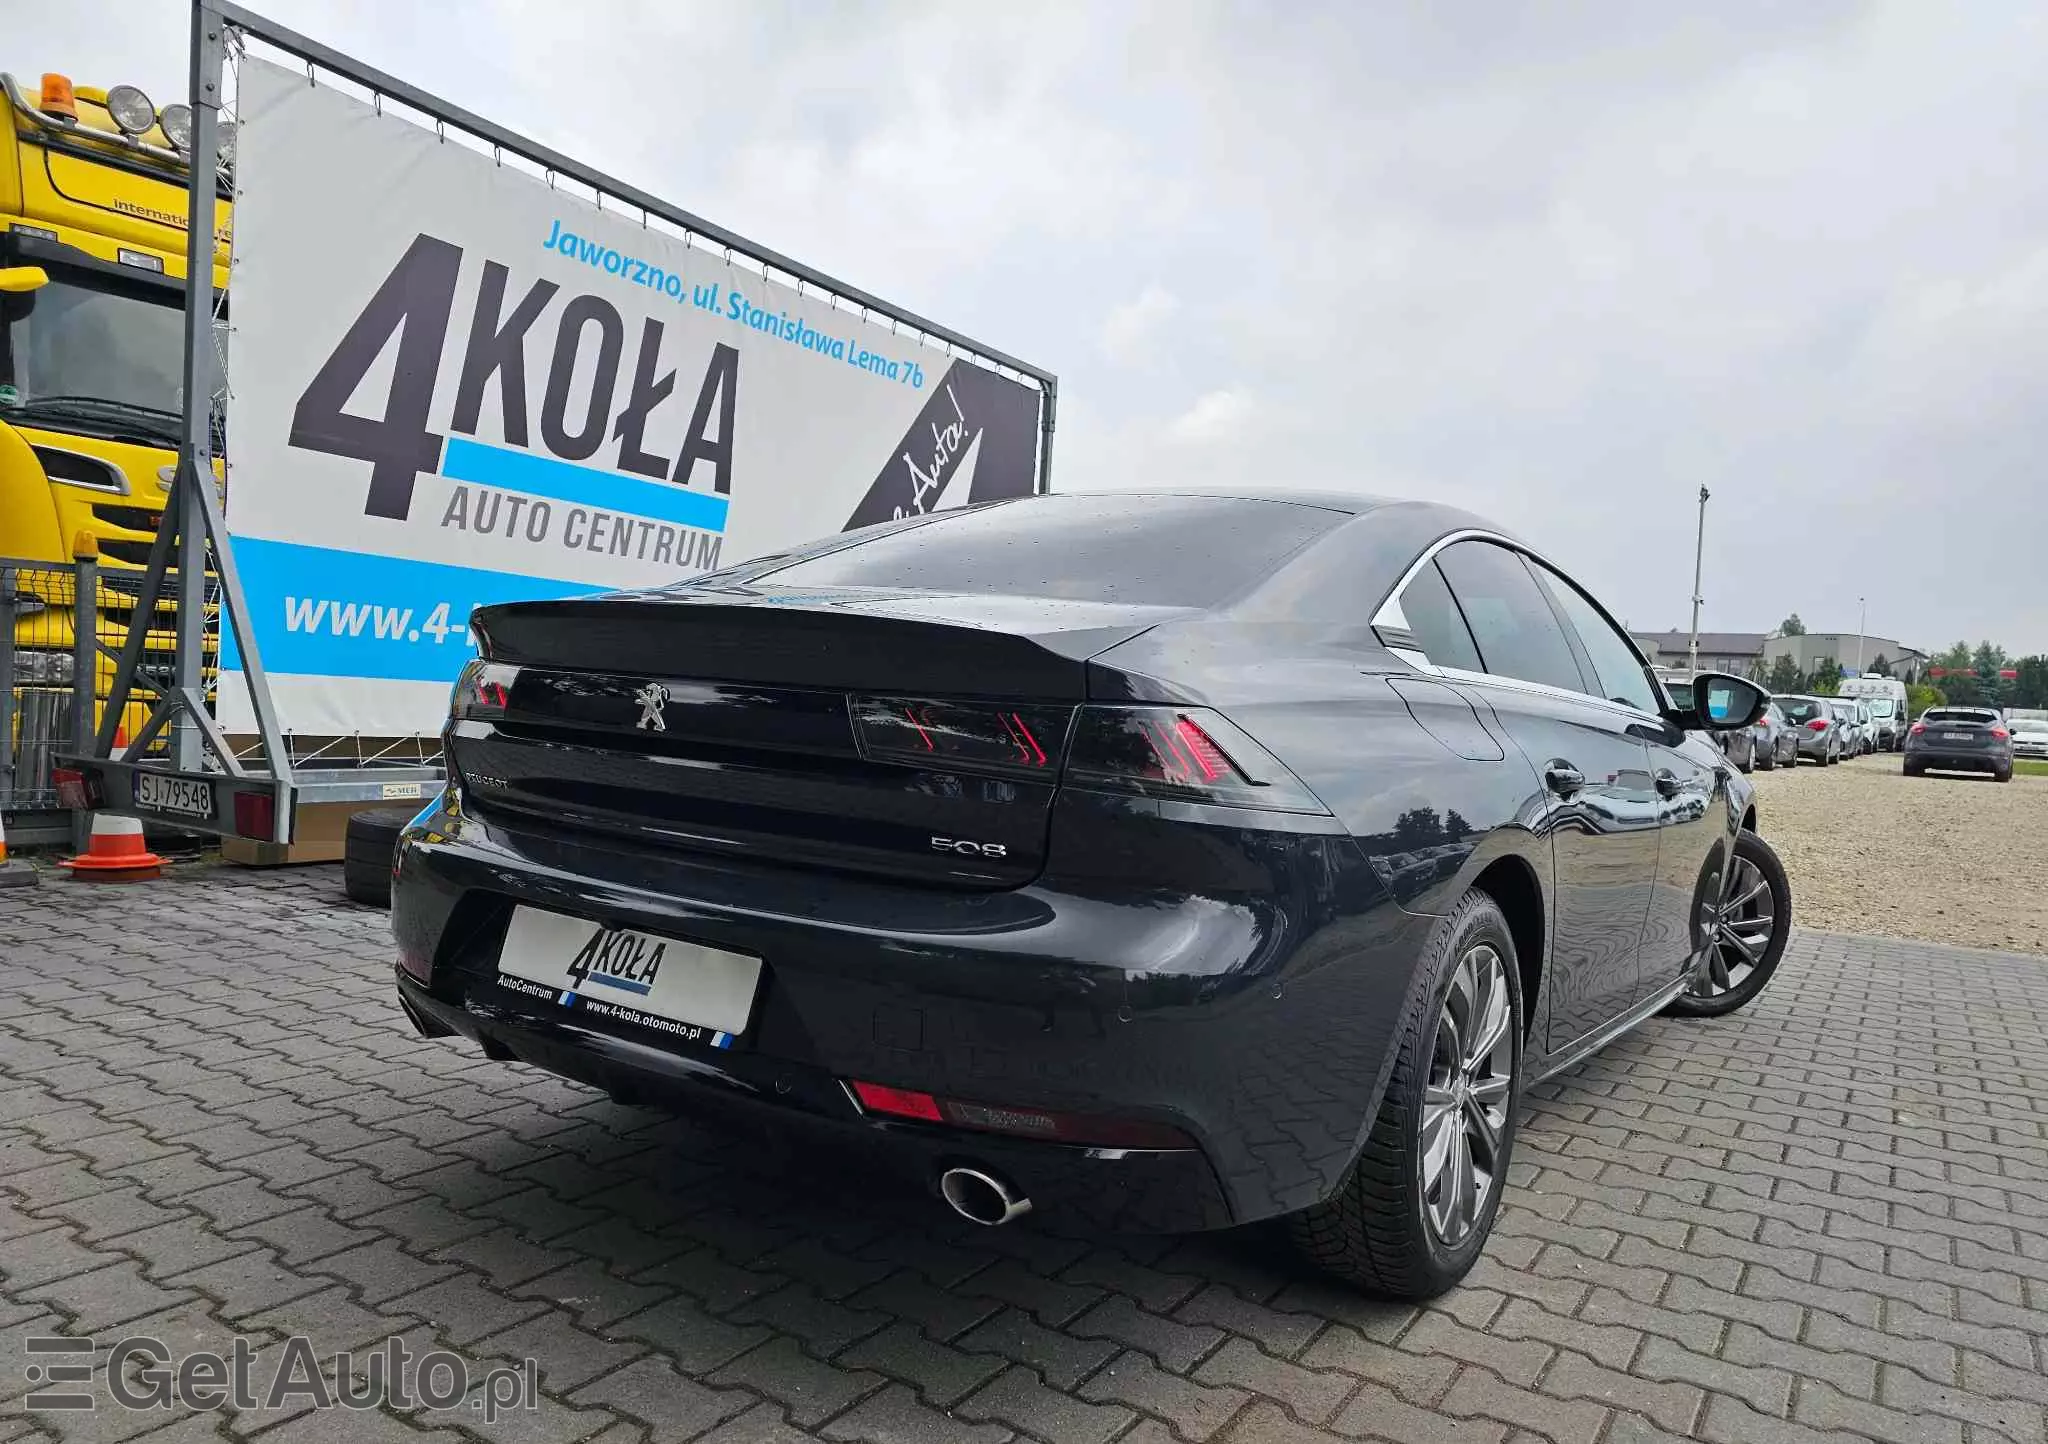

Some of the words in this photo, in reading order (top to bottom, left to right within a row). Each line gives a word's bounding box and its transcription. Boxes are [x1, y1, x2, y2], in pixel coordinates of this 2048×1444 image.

[543, 219, 688, 304] Jaworzno,
[693, 283, 723, 314] ul.
[726, 291, 845, 361] Stanisława
[847, 339, 899, 381] Lema
[901, 360, 925, 389] 7b
[441, 486, 552, 543] AUTO
[563, 508, 724, 571] CENTRUM
[141, 775, 160, 803] SJ
[165, 779, 209, 811] 79548
[931, 836, 1007, 858] 508
[497, 974, 553, 1001] AutoCentrum
[586, 999, 702, 1041] www.4-kola.otomoto.pl
